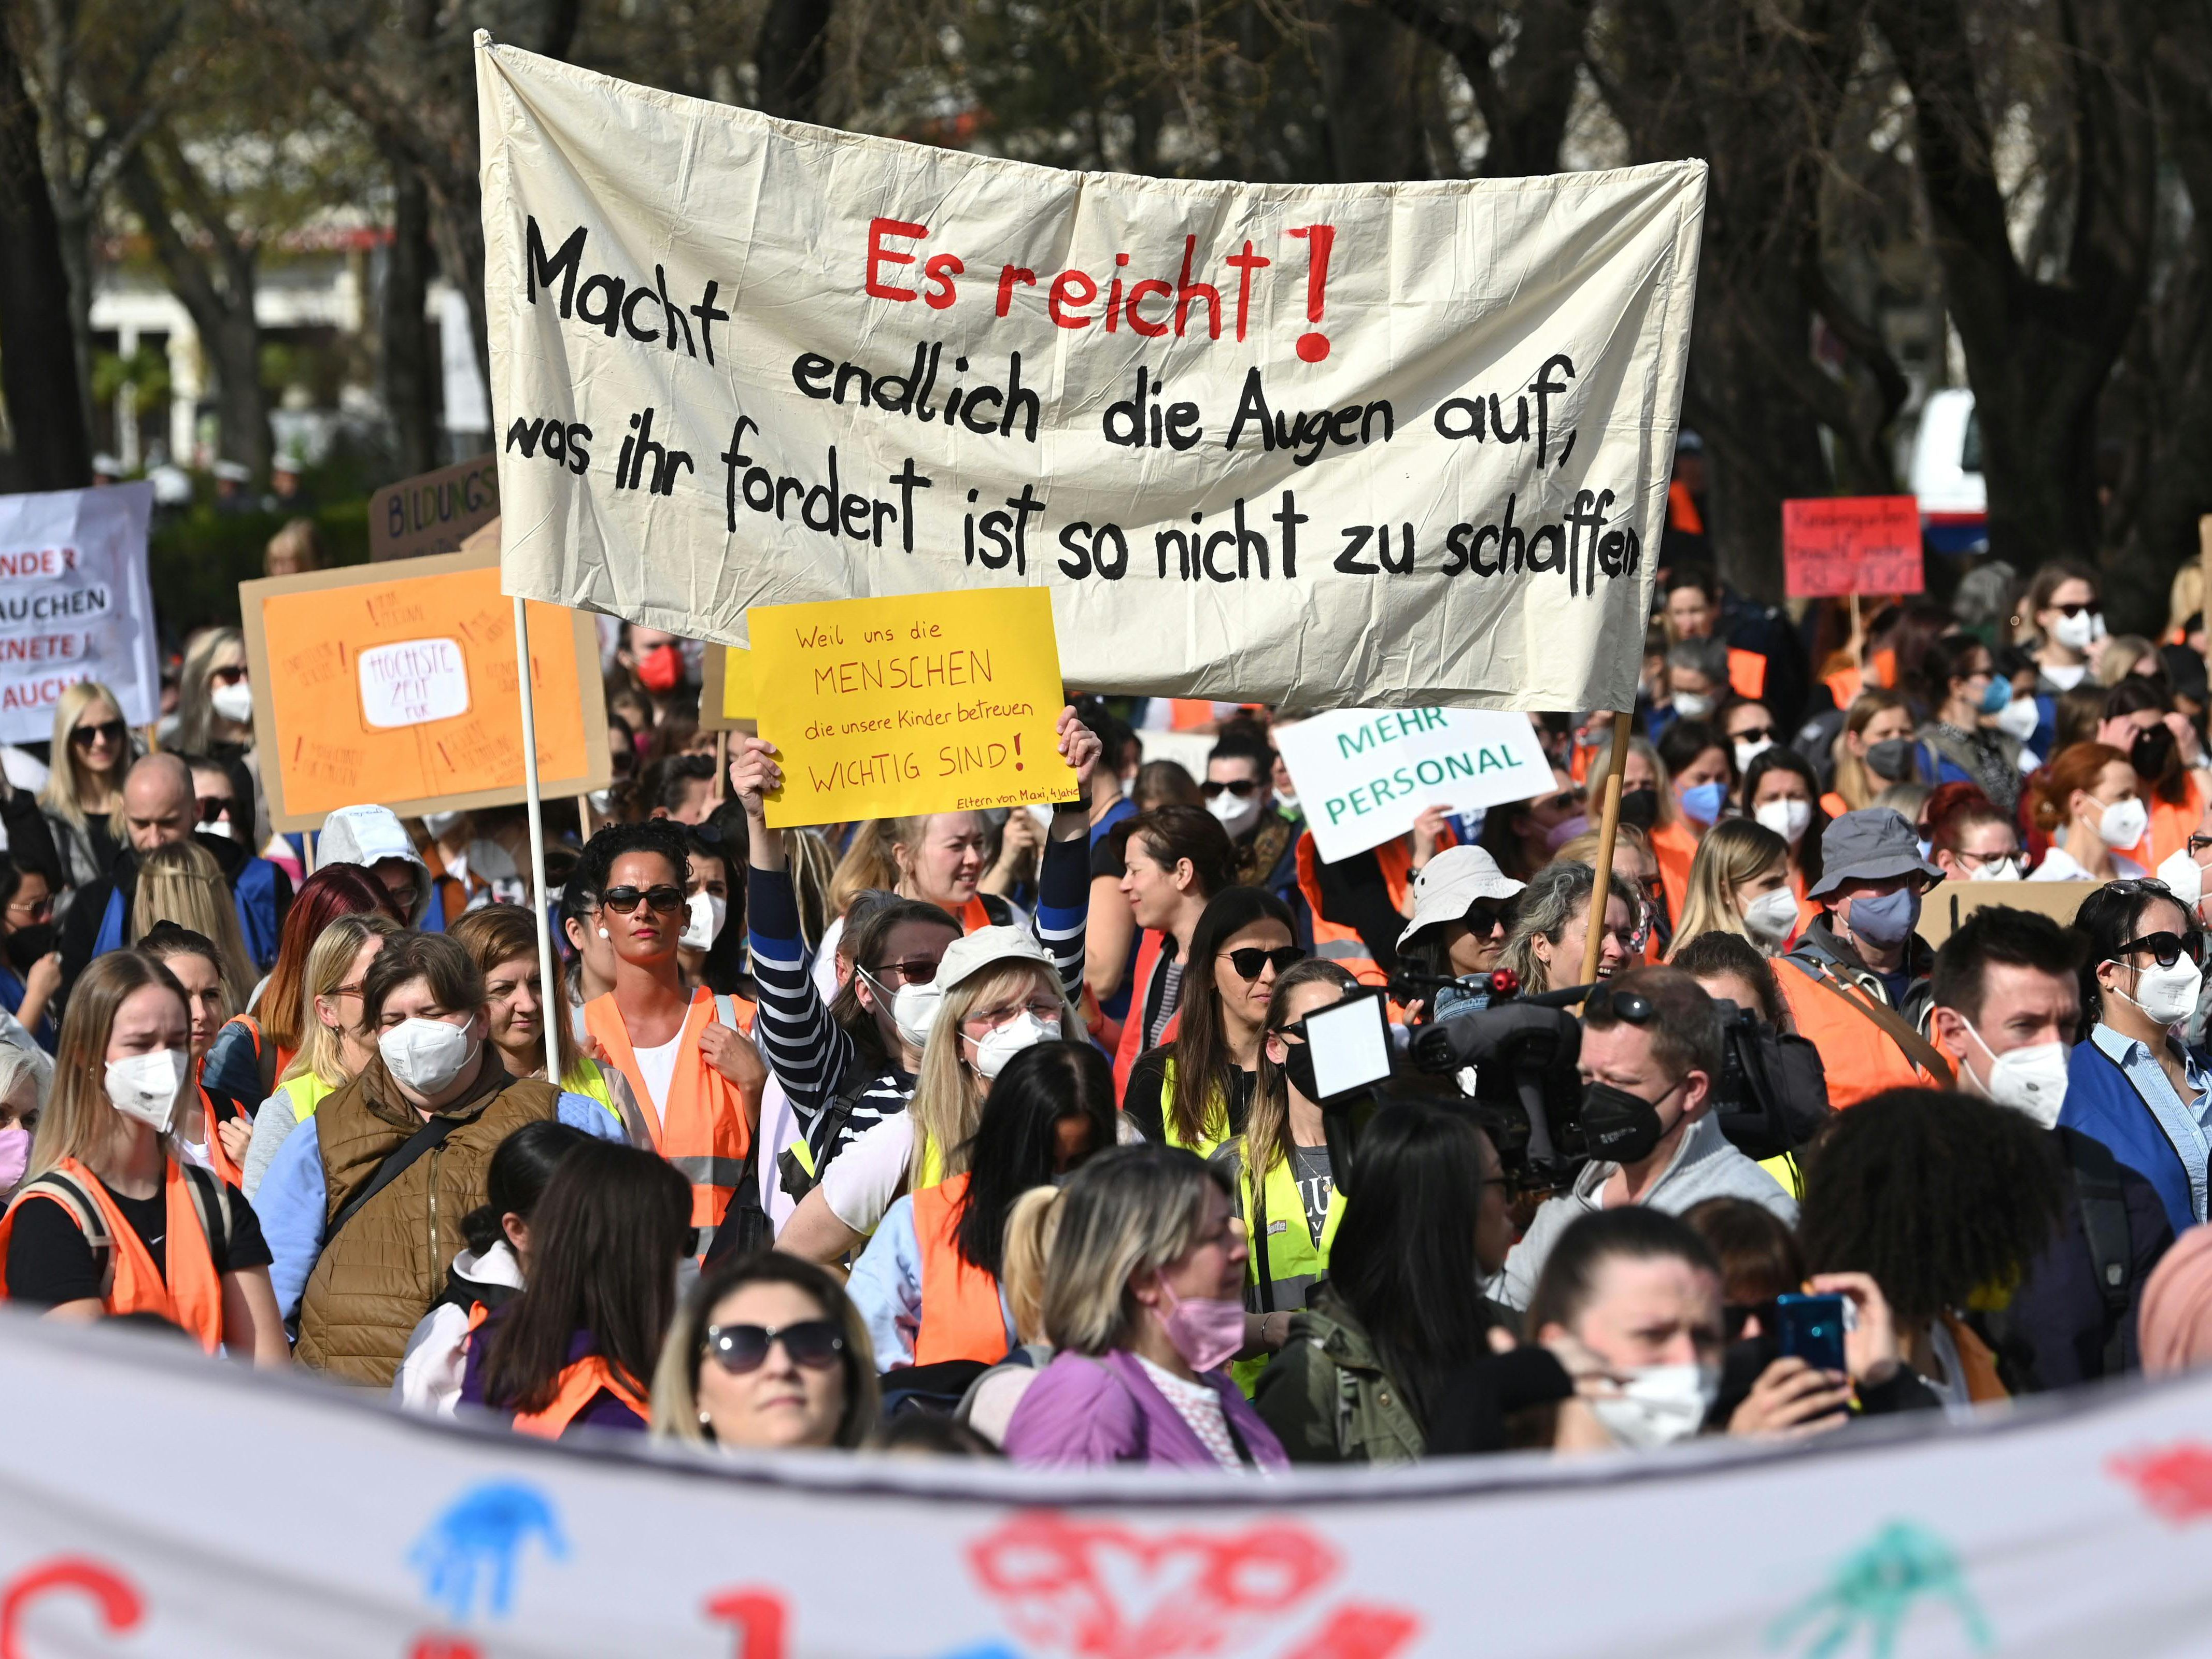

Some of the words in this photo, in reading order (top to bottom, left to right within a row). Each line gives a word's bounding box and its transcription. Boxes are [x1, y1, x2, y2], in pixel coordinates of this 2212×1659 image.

[866, 218, 964, 309] Es
[527, 215, 729, 367] Macht
[792, 341, 1040, 442] endlich
[1103, 366, 1202, 451] die
[1224, 366, 1394, 466] Augen
[1435, 355, 1577, 469] auf,
[506, 417, 592, 475] was
[616, 408, 693, 495] ihr
[721, 415, 933, 554] fordert
[965, 484, 1045, 576] ist
[1058, 521, 1128, 580] so
[1155, 490, 1309, 583] nicht
[1334, 522, 1414, 575] zu
[1440, 489, 1640, 597] schaffen
[796, 625, 843, 649] Weil
[864, 629, 894, 643] uns
[910, 621, 942, 640] die
[815, 648, 992, 695] MENSCHEN
[805, 722, 835, 740] die
[842, 718, 892, 735] unsere
[898, 708, 952, 729] Kinder
[957, 699, 1033, 722] betreuen
[1337, 707, 1449, 759] MEHR
[808, 753, 920, 793] WICHTIG
[939, 732, 1024, 777] SIND!
[1325, 744, 1523, 825] PERSONAL
[957, 797, 992, 809] Eltern
[996, 795, 1016, 804] von
[1019, 787, 1048, 801] Maxi,
[1051, 788, 1056, 796] 4
